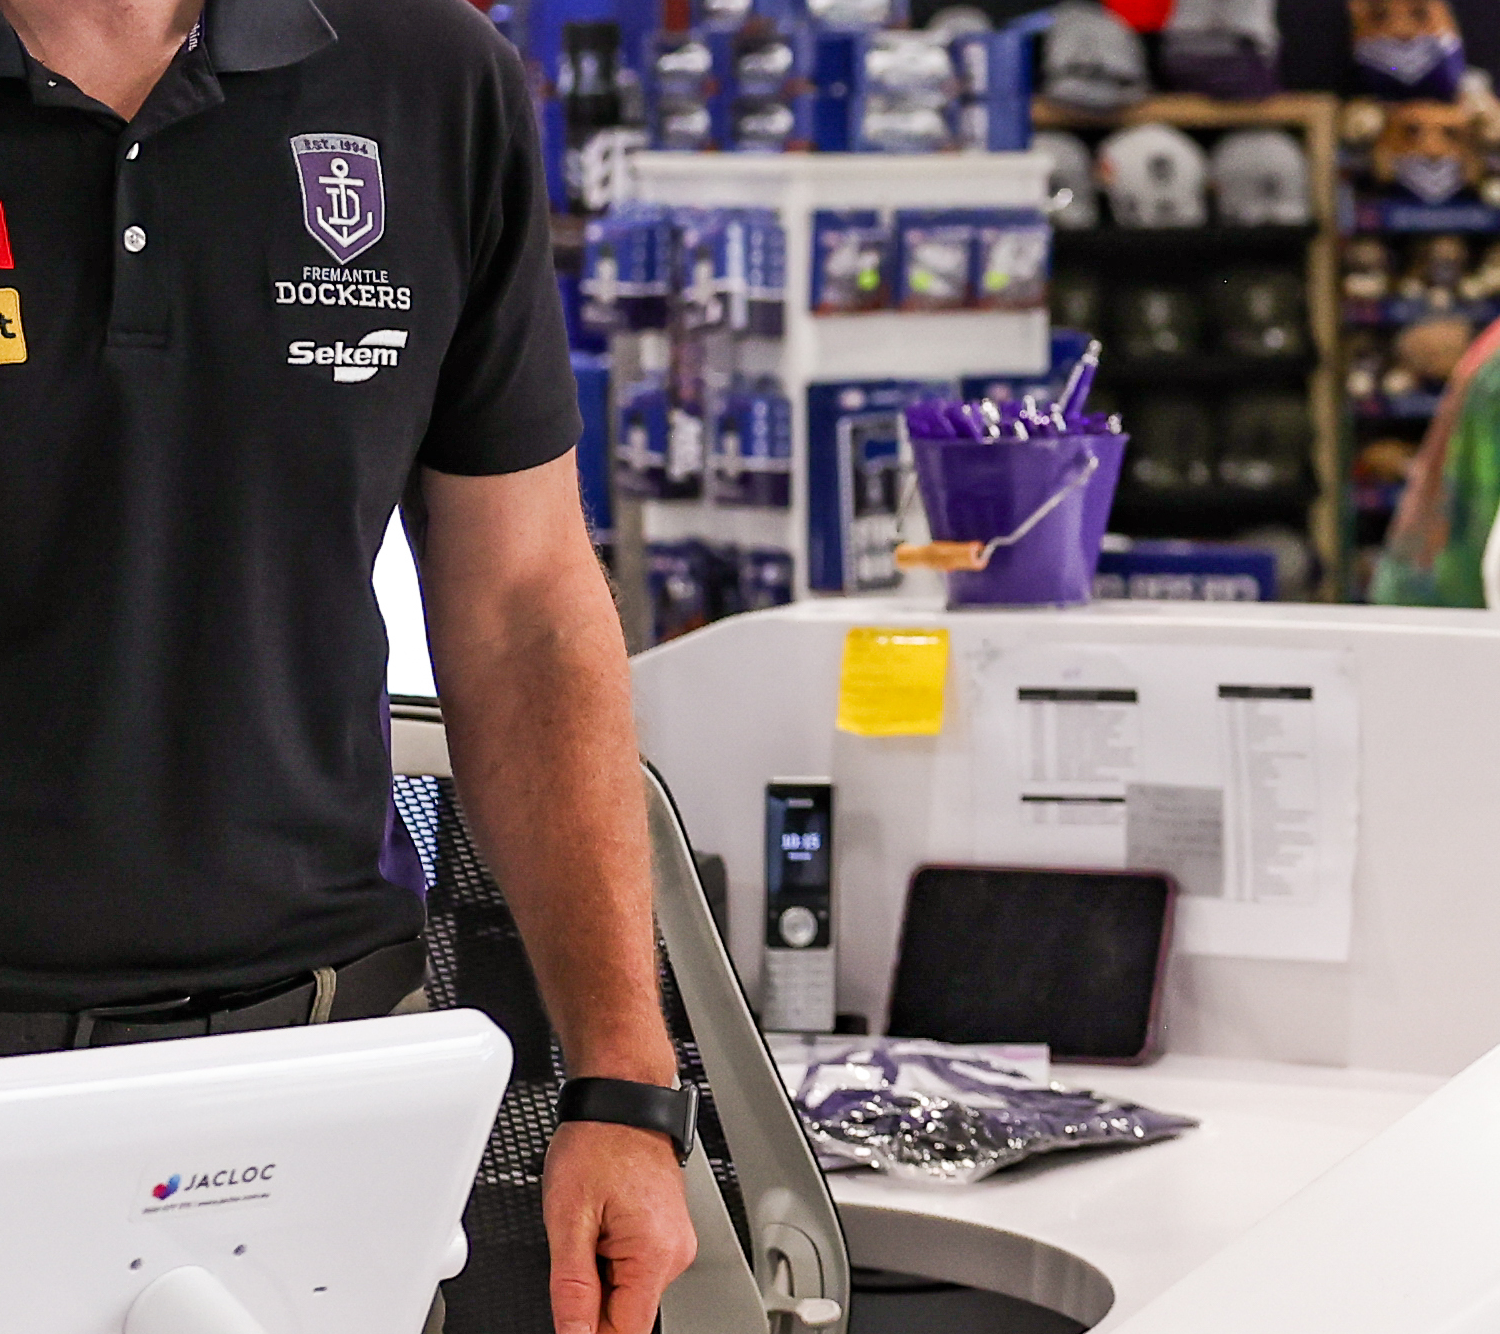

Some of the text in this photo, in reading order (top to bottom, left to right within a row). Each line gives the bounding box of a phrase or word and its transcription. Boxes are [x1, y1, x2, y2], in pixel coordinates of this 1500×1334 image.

[340, 140, 368, 154] 1994
[302, 266, 389, 284] FREMANTLE
[275, 281, 411, 310] DOCKERS
[287, 341, 398, 366] Sekem
[184, 1163, 276, 1191] JACLOC
